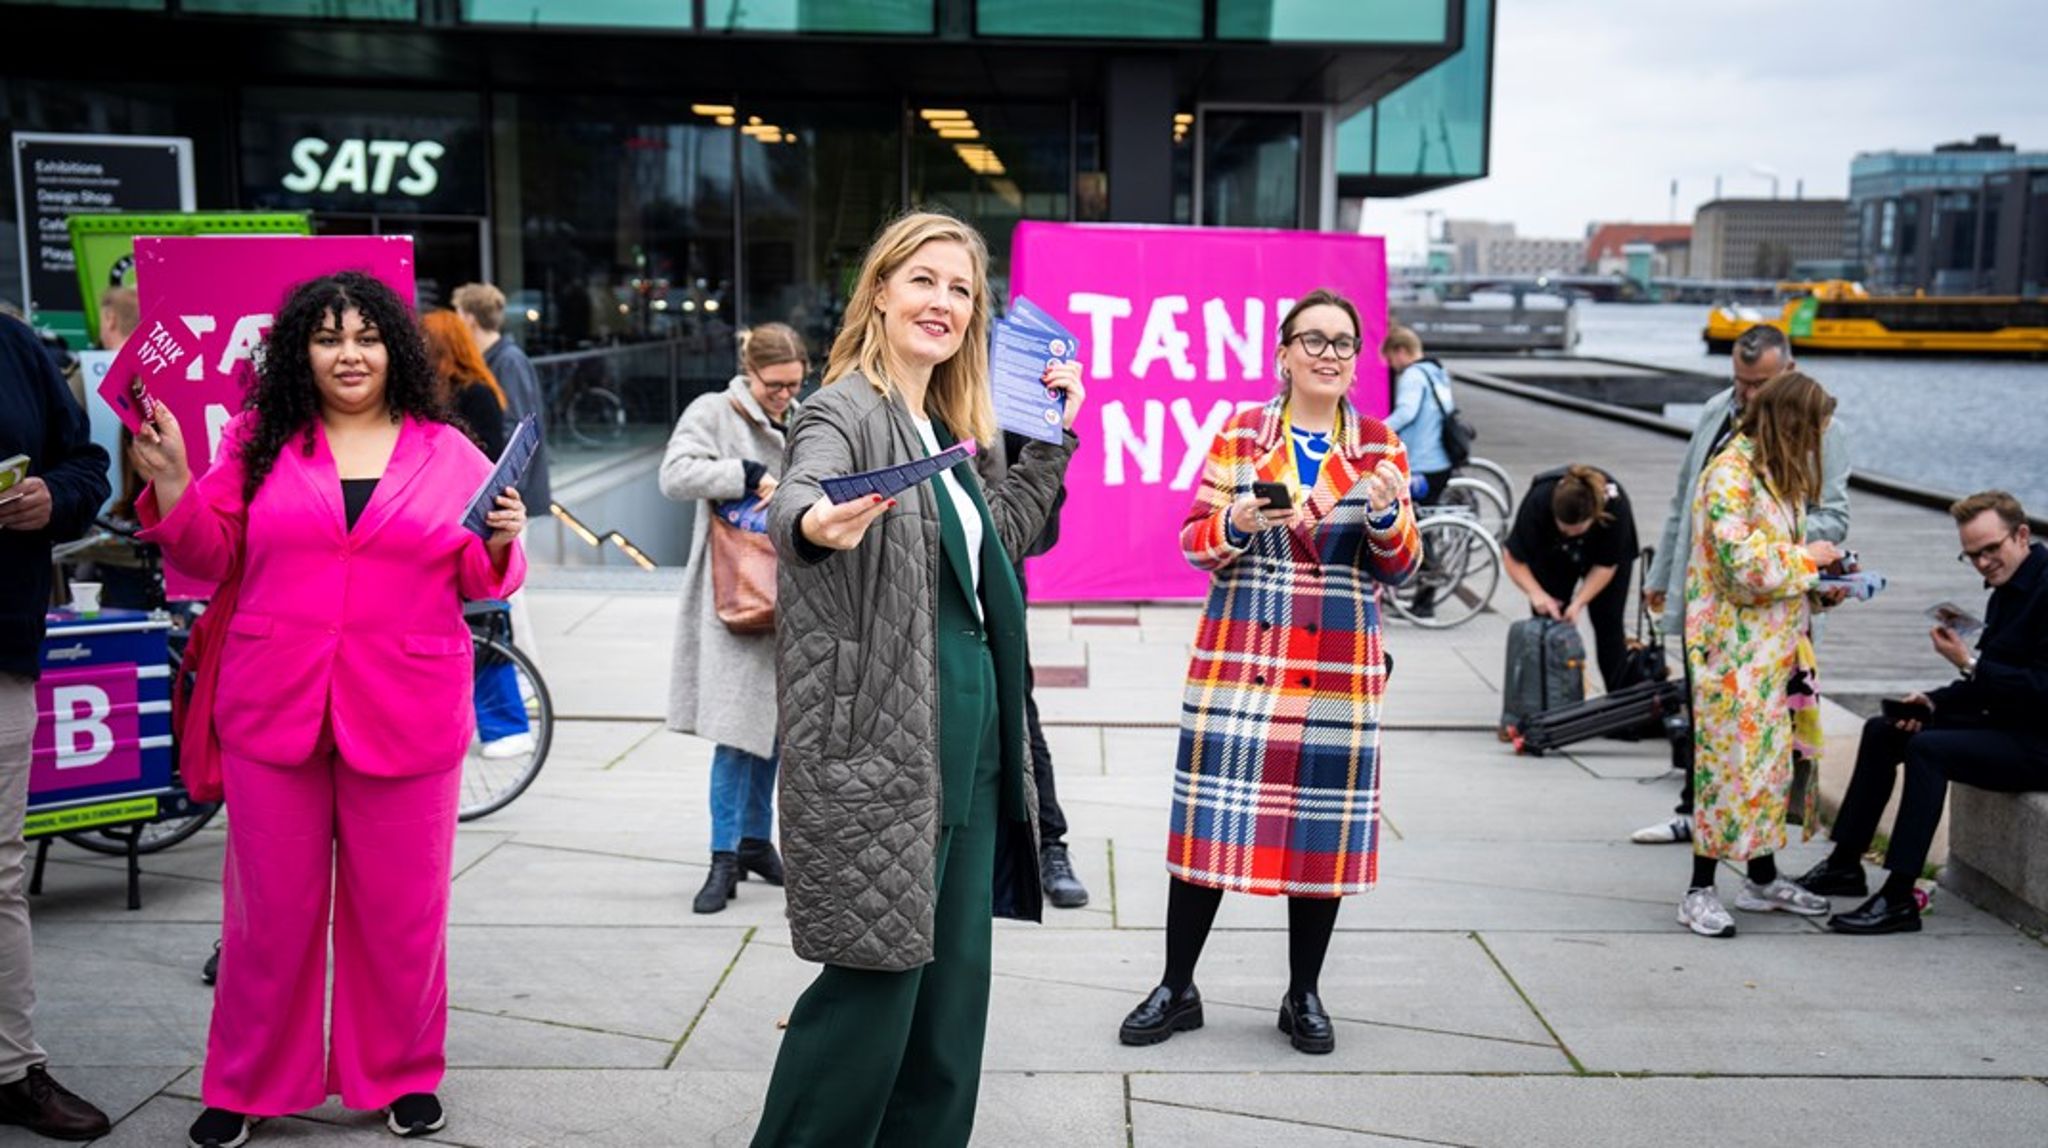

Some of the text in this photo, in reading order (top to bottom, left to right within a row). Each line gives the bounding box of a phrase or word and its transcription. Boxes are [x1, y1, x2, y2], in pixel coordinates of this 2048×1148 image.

[281, 137, 446, 196] SATS
[37, 188, 113, 206] Design Shop
[137, 341, 167, 374] NYT
[1101, 398, 1268, 490] NY
[53, 684, 115, 769] B
